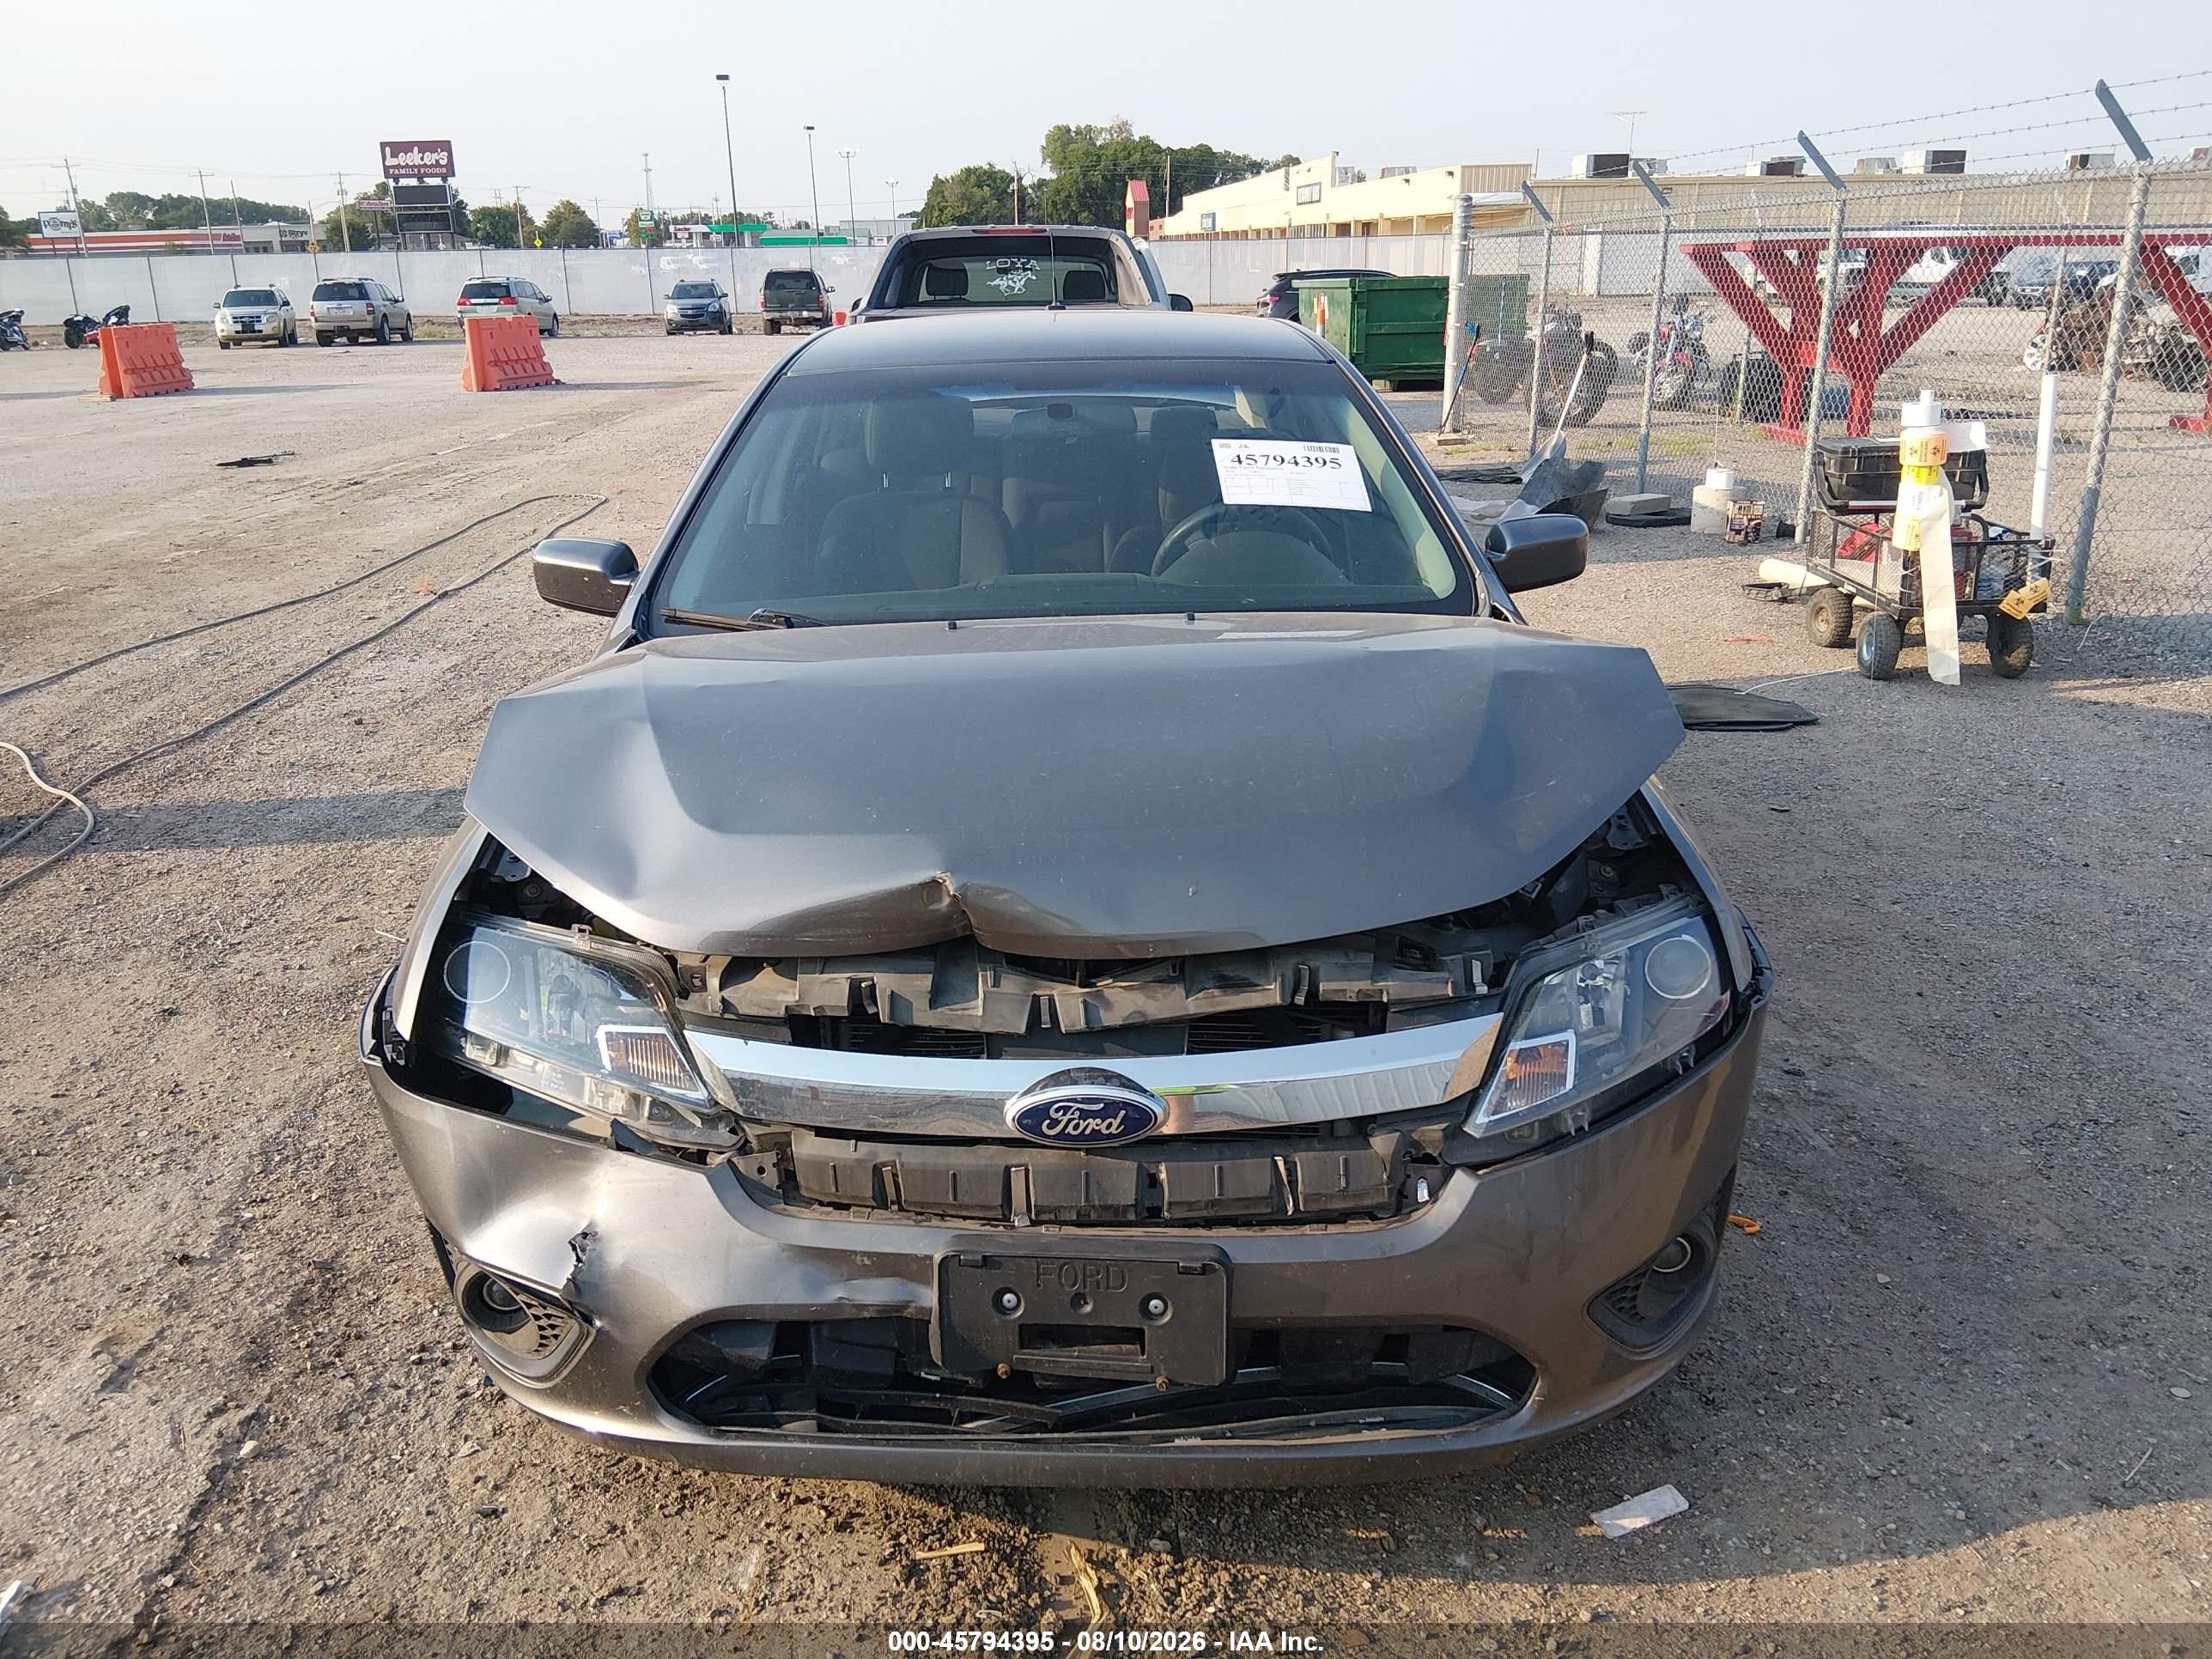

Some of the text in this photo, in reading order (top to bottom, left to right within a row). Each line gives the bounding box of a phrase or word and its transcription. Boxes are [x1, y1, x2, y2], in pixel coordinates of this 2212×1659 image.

[385, 145, 448, 166] Leeker's
[1231, 453, 1342, 470] 45794395
[1041, 1101, 1124, 1136] Ford
[1035, 1261, 1128, 1292] FORD
